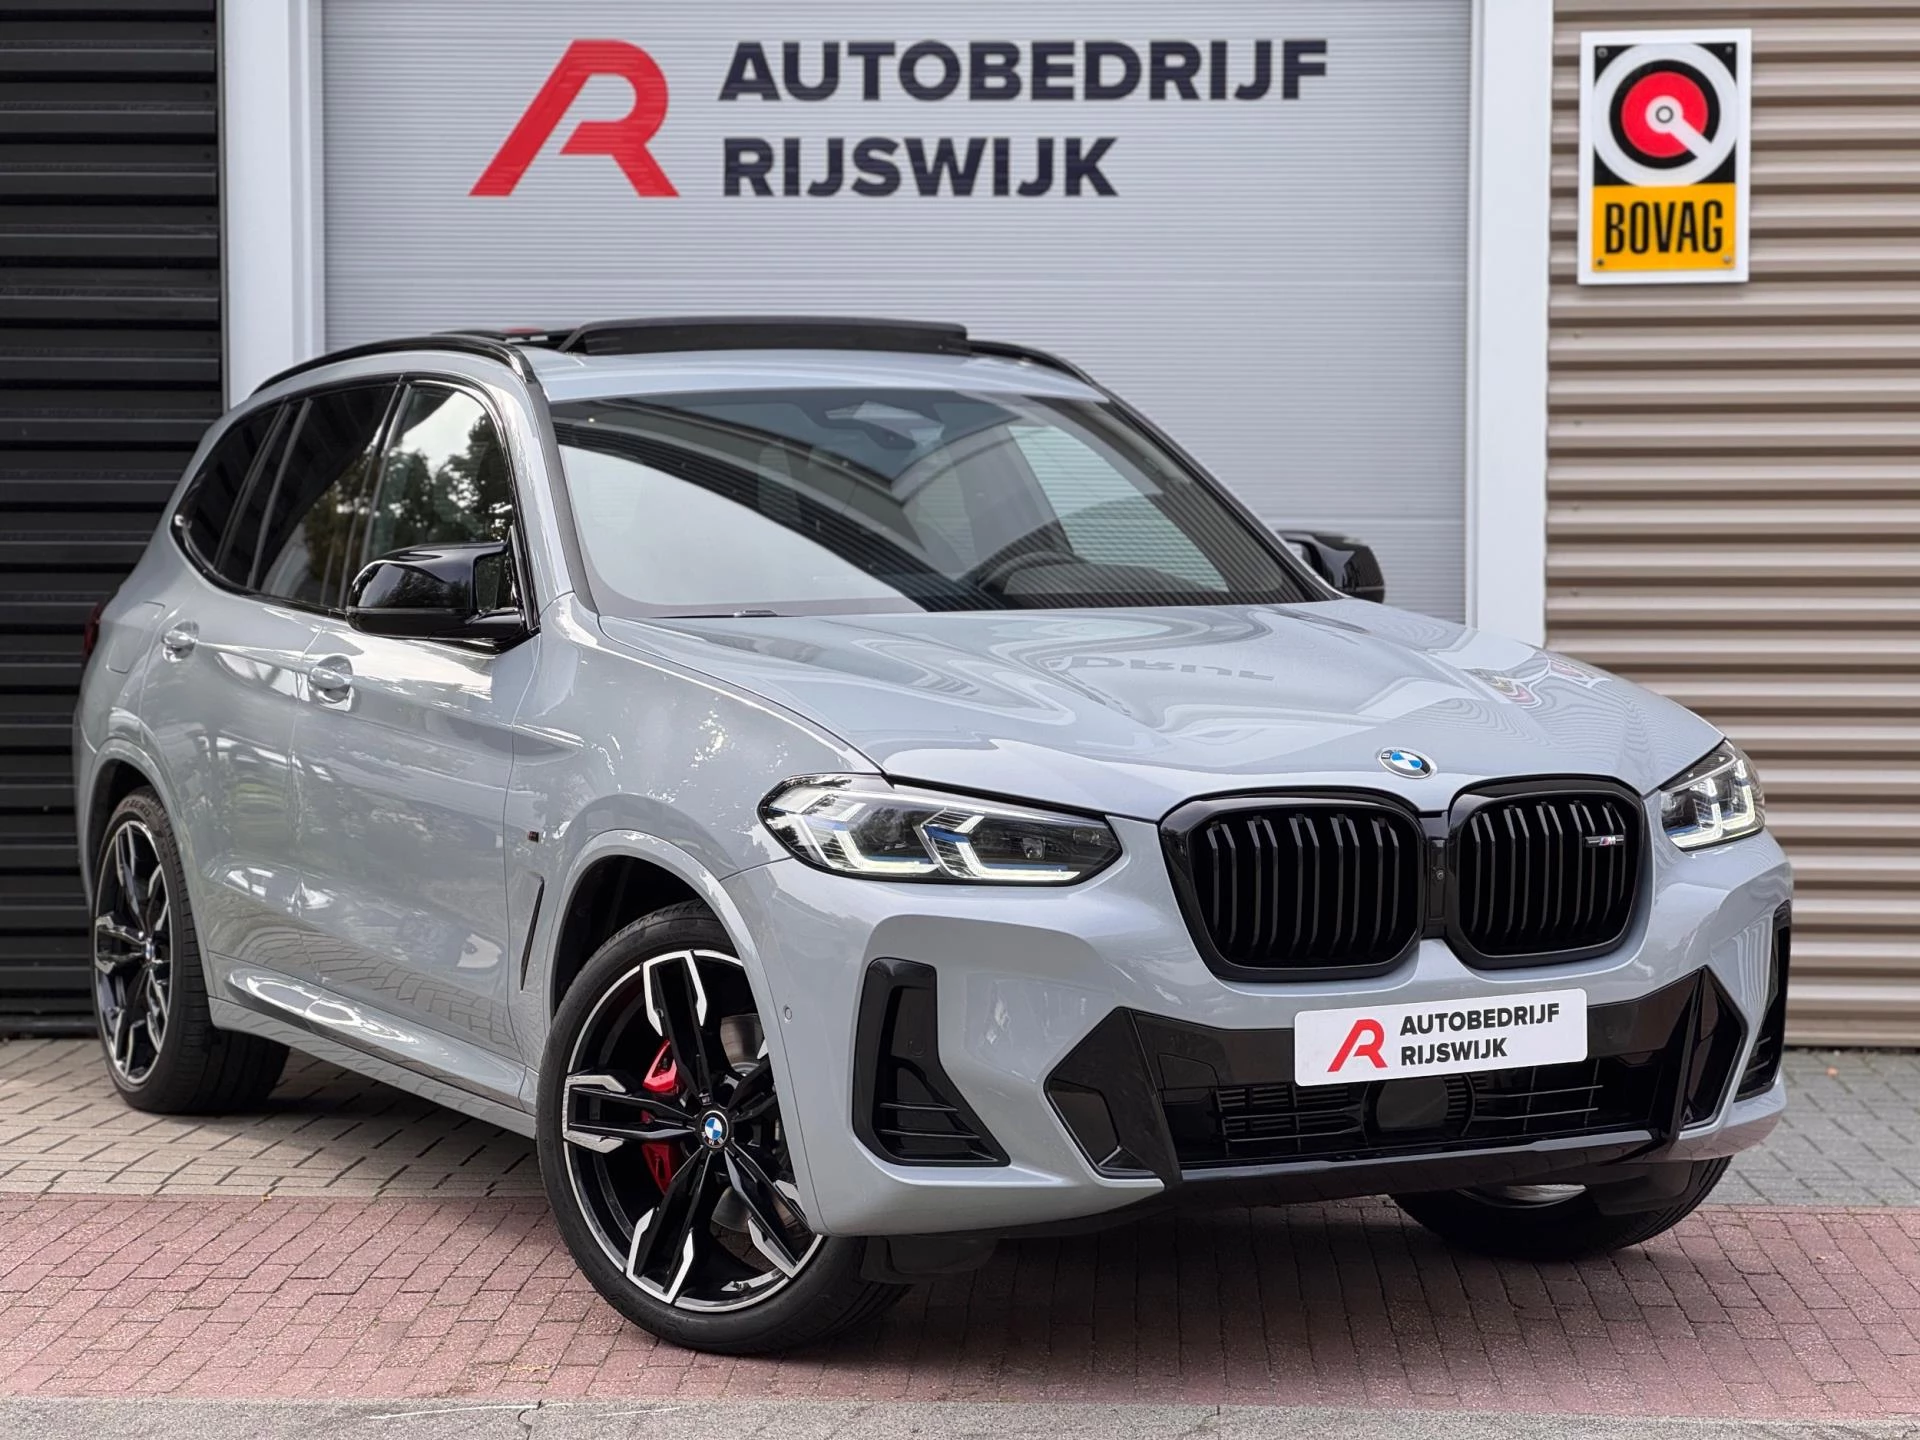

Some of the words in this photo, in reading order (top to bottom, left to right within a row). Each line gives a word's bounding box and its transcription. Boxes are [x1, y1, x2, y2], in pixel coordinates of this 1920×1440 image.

[719, 40, 1328, 102] AUTOBEDRIJF
[724, 137, 1118, 198] RIJSWIJK
[1604, 199, 1723, 255] BOVAG
[1400, 1002, 1560, 1036] AUTOBEDRIJF
[1401, 1037, 1508, 1066] RIJSWIJK
